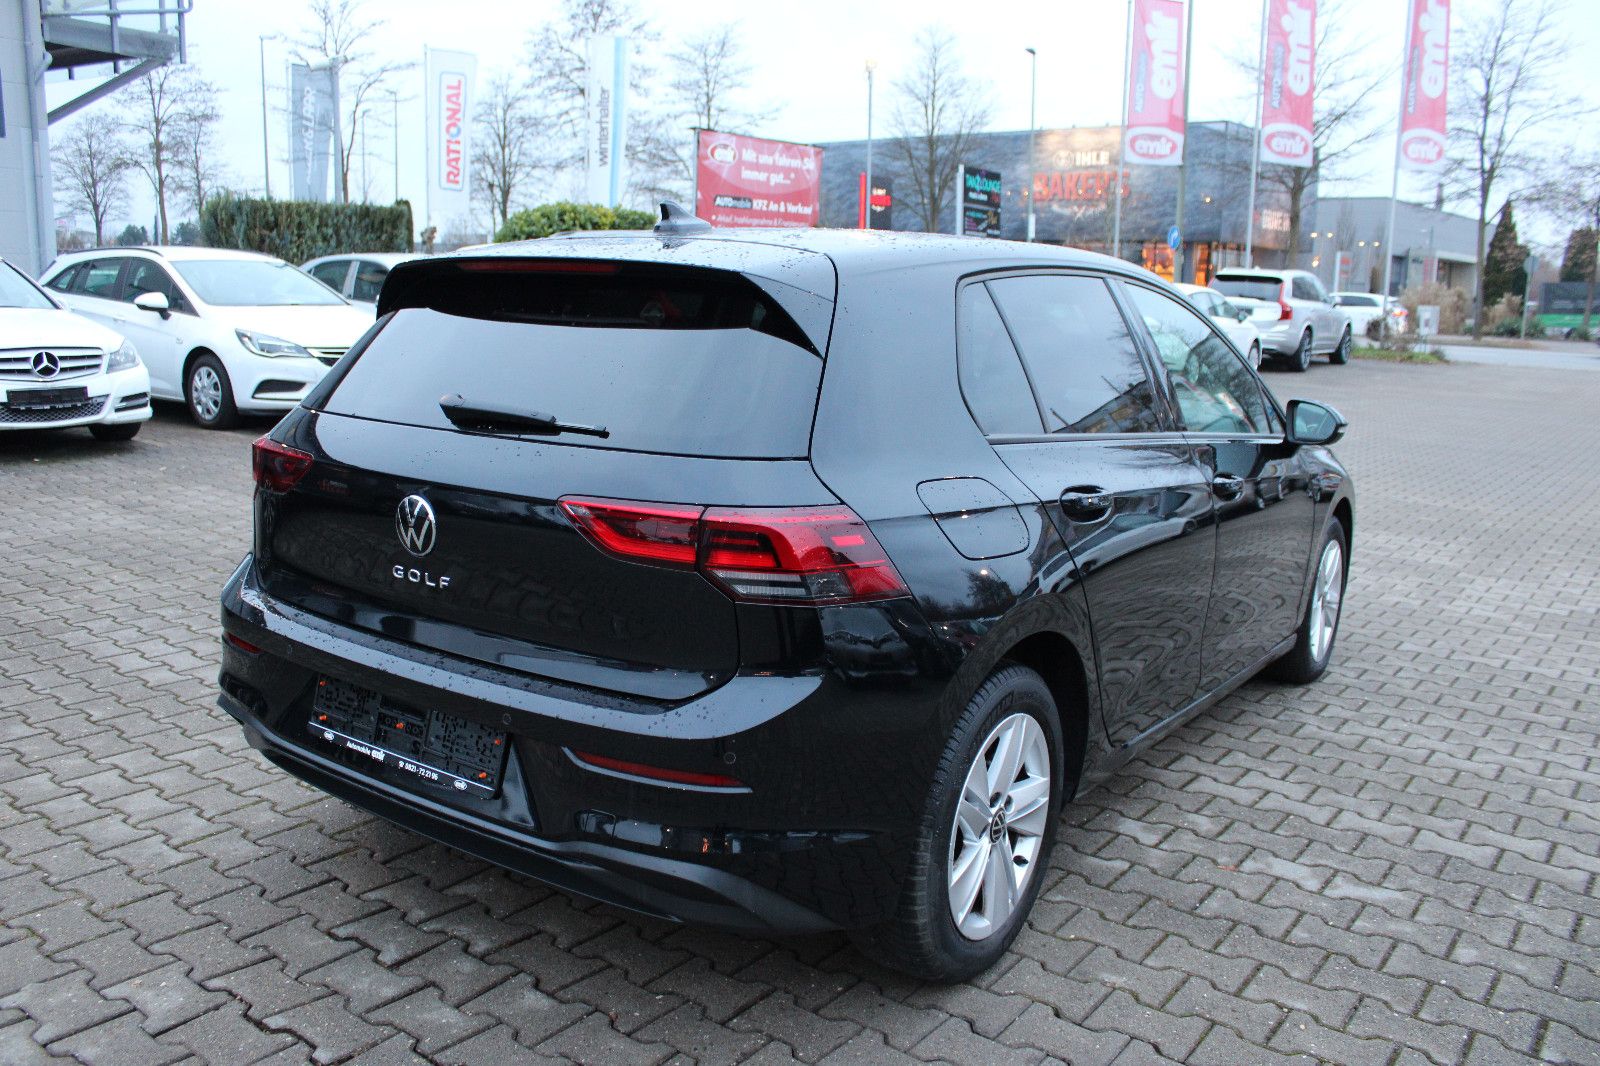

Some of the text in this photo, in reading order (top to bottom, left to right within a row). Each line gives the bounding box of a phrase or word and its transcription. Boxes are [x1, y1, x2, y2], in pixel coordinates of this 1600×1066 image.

[1145, 9, 1179, 100] emir
[446, 80, 462, 185] RATIONAL
[595, 86, 610, 168] winterhalter
[1134, 137, 1173, 156] emir
[1271, 135, 1307, 154] emir
[392, 565, 451, 589] GOLF
